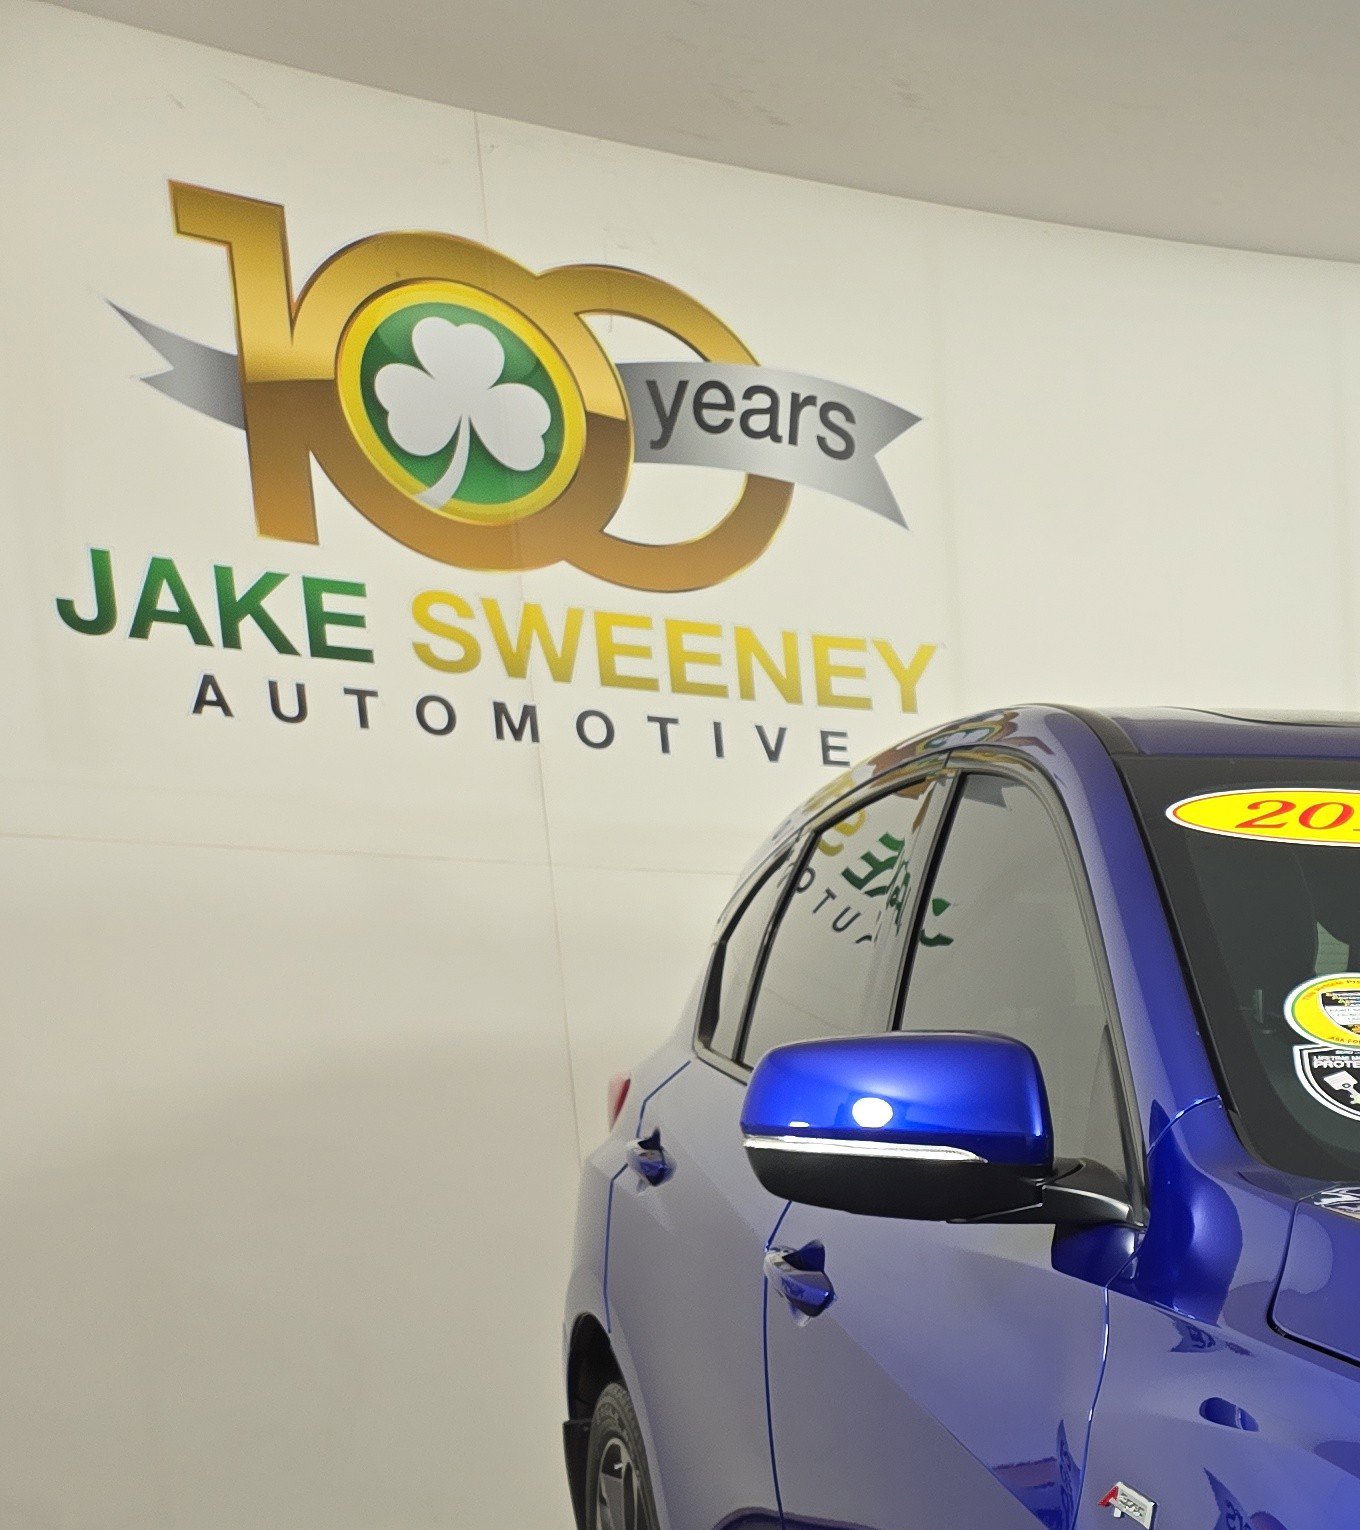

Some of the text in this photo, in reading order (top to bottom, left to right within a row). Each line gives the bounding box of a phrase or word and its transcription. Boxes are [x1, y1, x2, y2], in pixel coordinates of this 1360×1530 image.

[168, 179, 795, 594] 100
[646, 376, 858, 461] years
[55, 547, 938, 714] JAKE SWEENEY
[192, 673, 852, 767] AUTOMOTIVE
